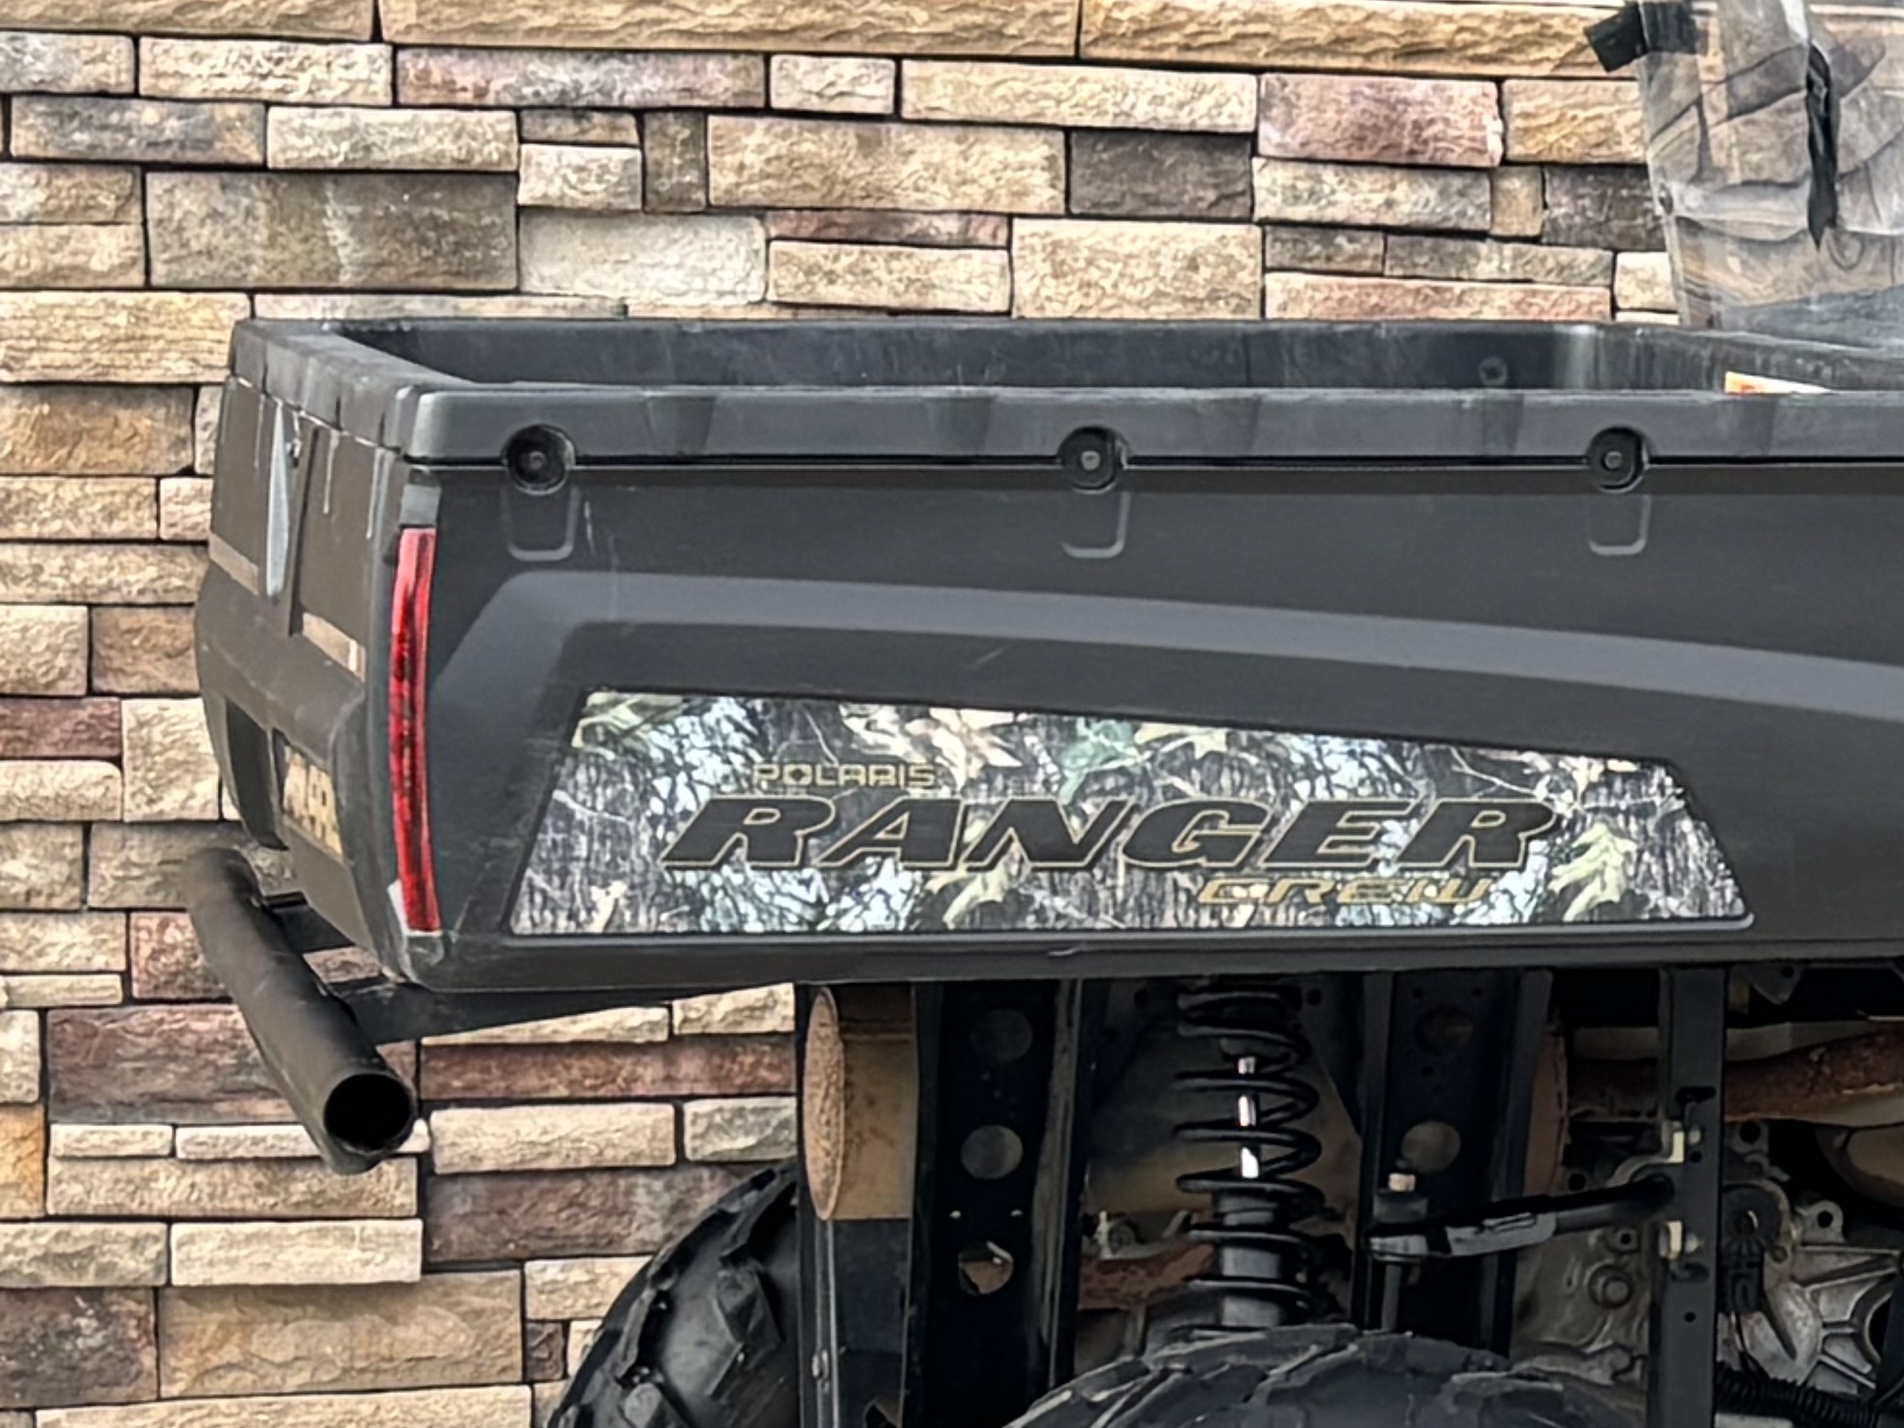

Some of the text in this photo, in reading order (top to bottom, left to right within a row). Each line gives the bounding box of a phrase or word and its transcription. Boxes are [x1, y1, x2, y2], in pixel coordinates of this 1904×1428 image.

[751, 762, 936, 789] POLARIS
[657, 793, 1558, 870] RANGER
[1197, 876, 1496, 906] CREW
